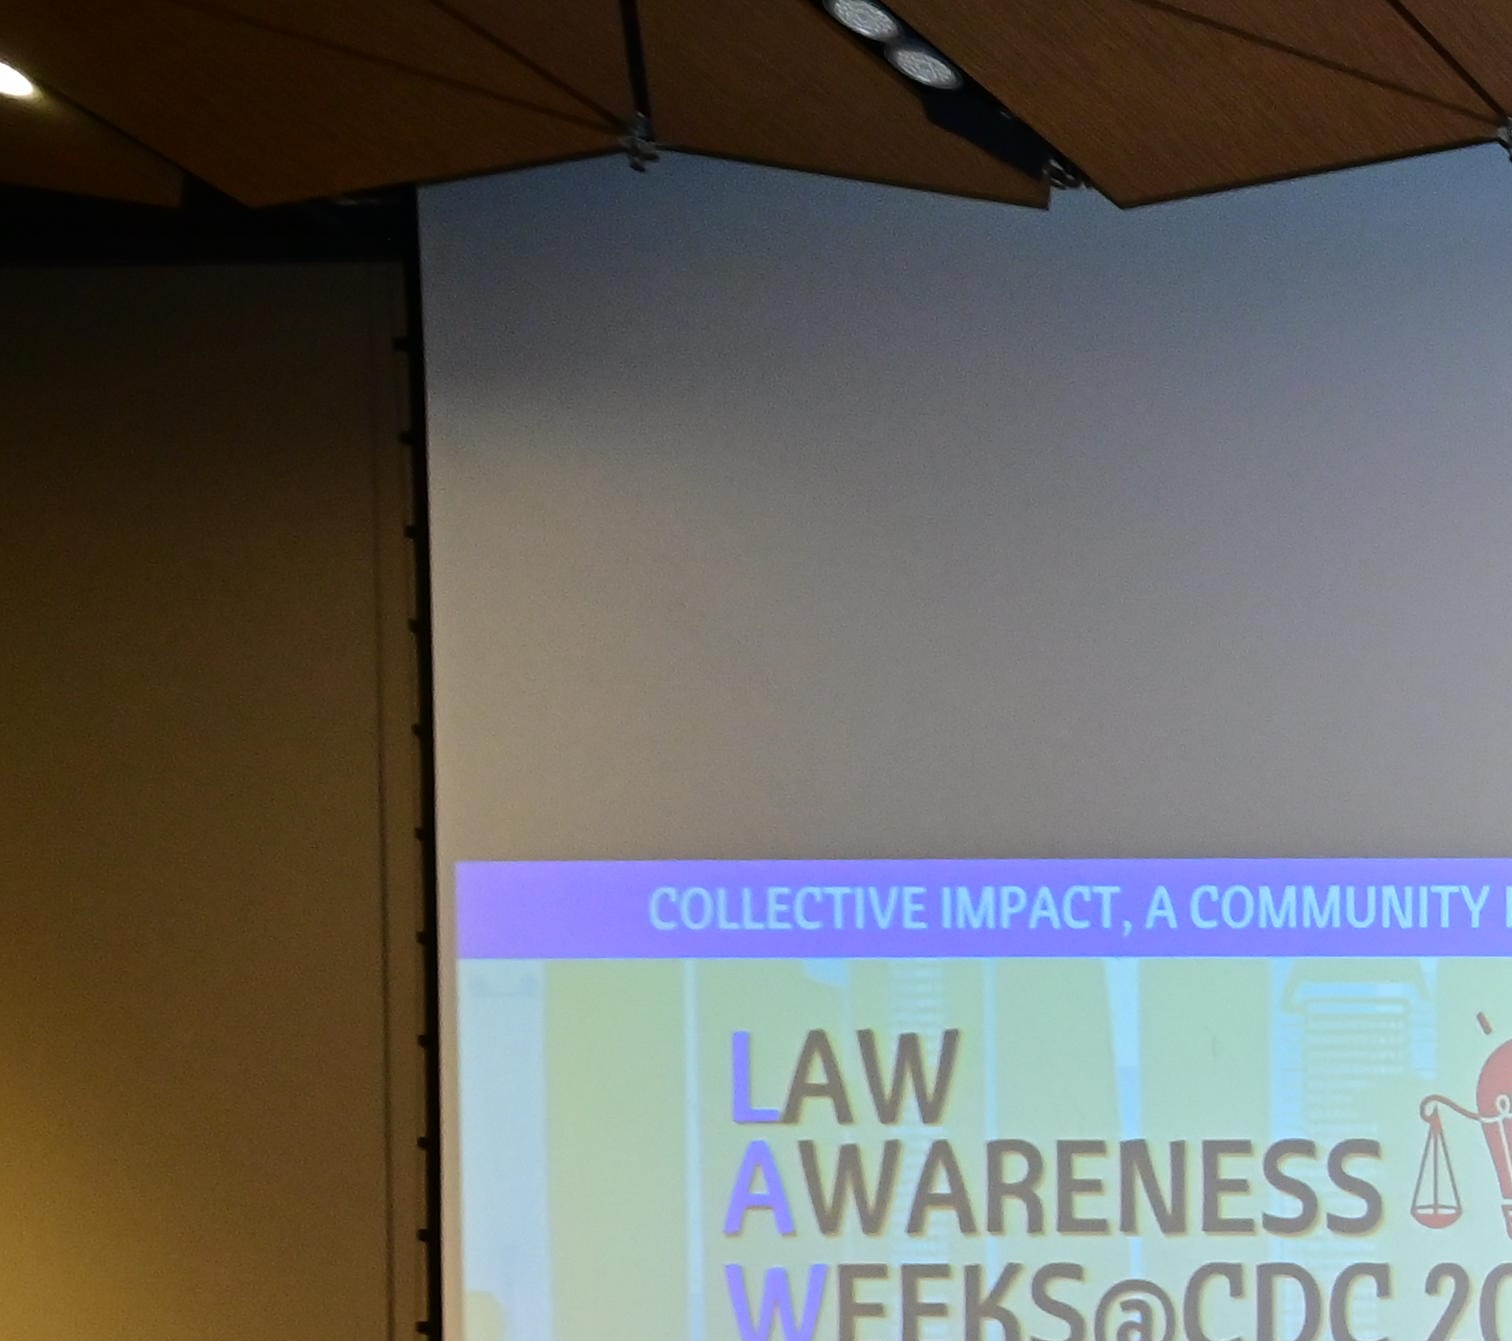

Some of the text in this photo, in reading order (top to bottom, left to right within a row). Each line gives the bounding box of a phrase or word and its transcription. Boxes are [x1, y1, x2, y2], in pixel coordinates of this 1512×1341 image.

[648, 886, 928, 931] COLLECTIVE
[942, 885, 1133, 936] IMPACT,
[1145, 885, 1179, 929] A
[1190, 885, 1491, 929] COMMUNITY
[731, 1027, 960, 1125] LAW
[723, 1138, 1385, 1238] AWARENESS
